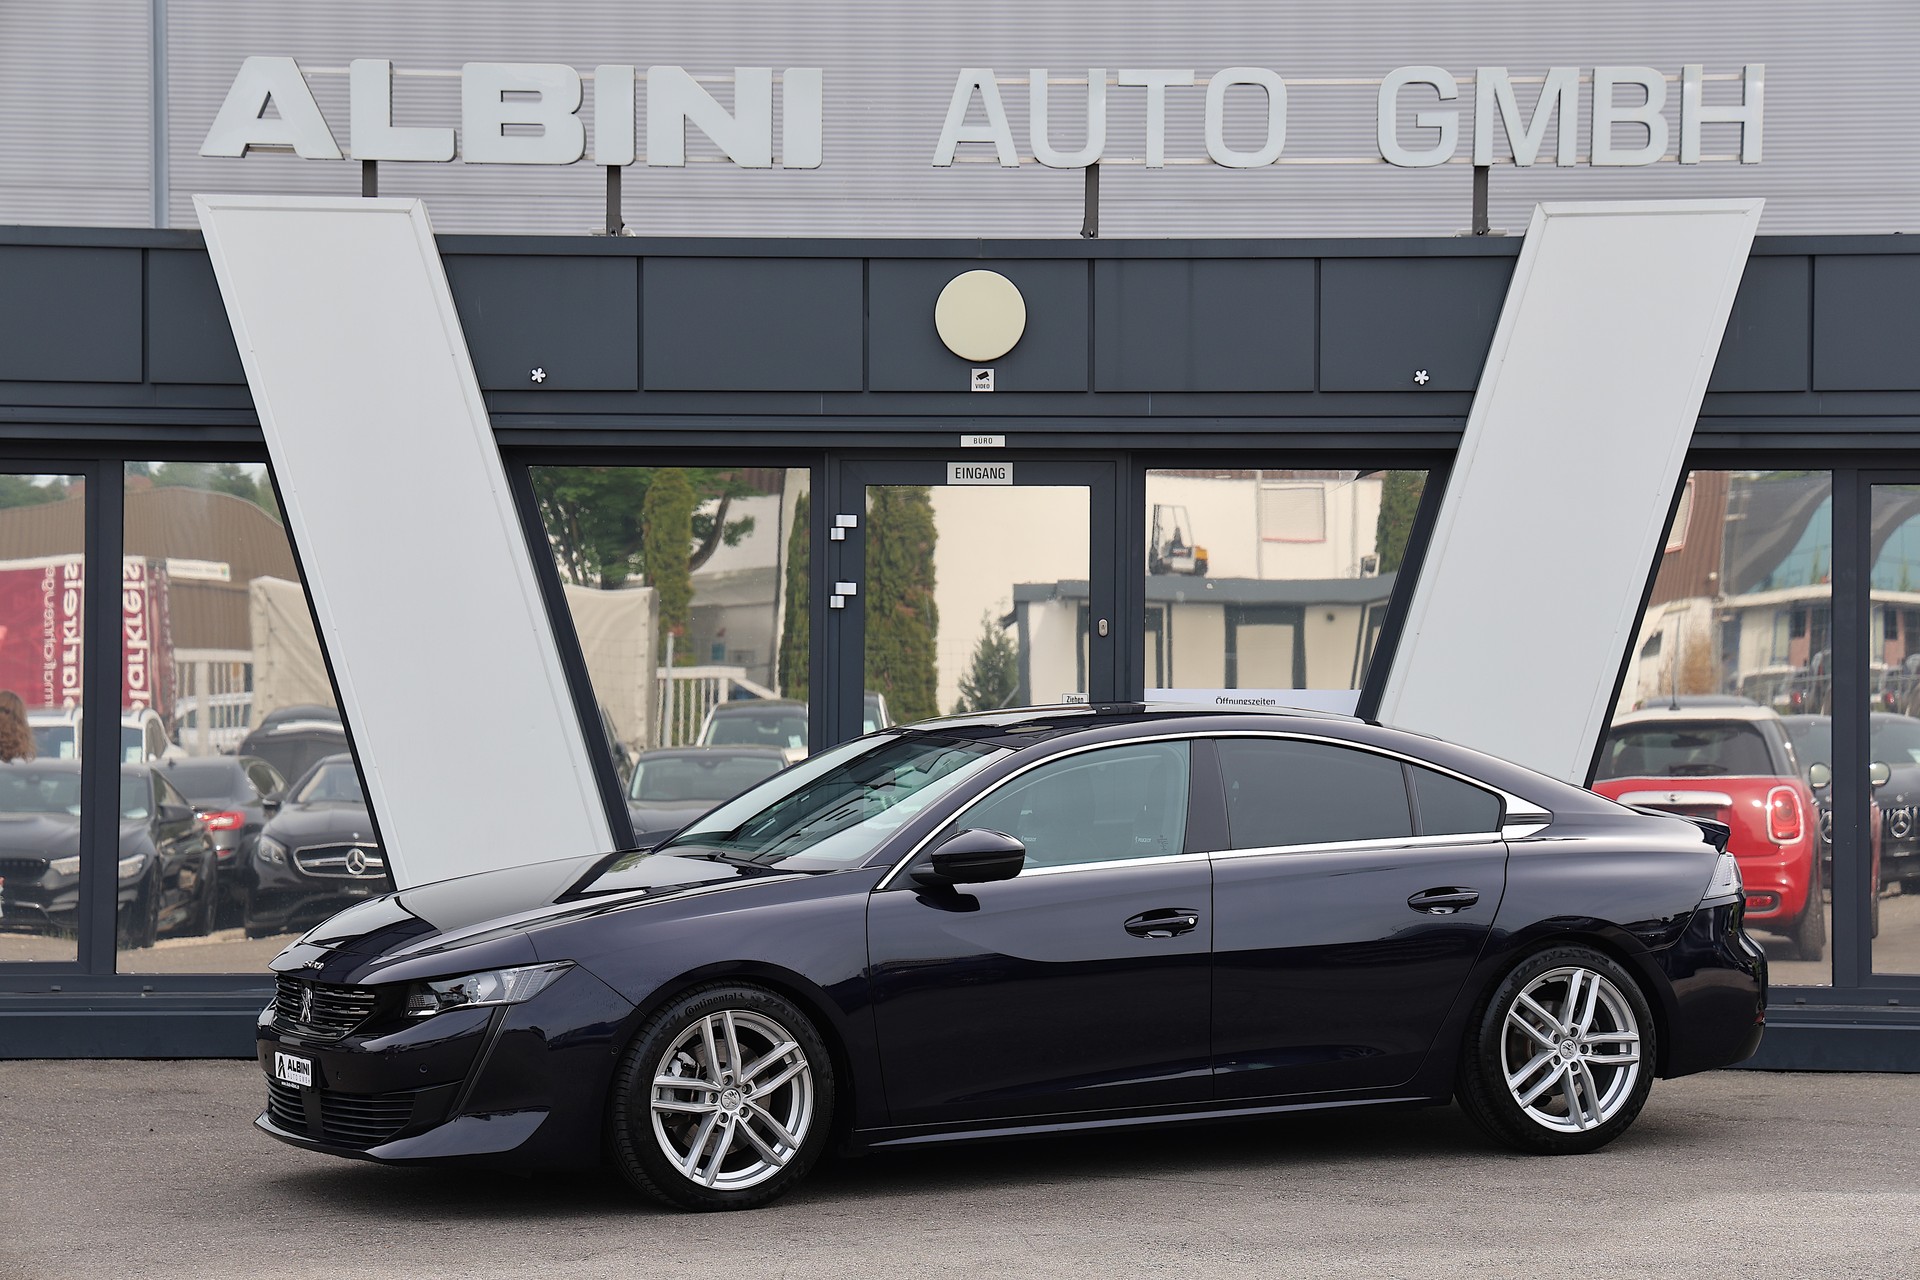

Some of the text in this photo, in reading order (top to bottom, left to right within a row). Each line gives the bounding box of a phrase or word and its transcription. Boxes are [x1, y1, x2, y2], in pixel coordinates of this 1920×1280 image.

[200, 56, 1765, 169] ALBINI AUTO GMBH
[973, 437, 993, 445] BÜRO
[955, 467, 1006, 480] EINGANG
[1066, 695, 1084, 704] Ziehen
[1215, 696, 1276, 706] Öffnungszeiten
[685, 992, 737, 1017] Continental
[287, 1058, 310, 1076] ALBINI
